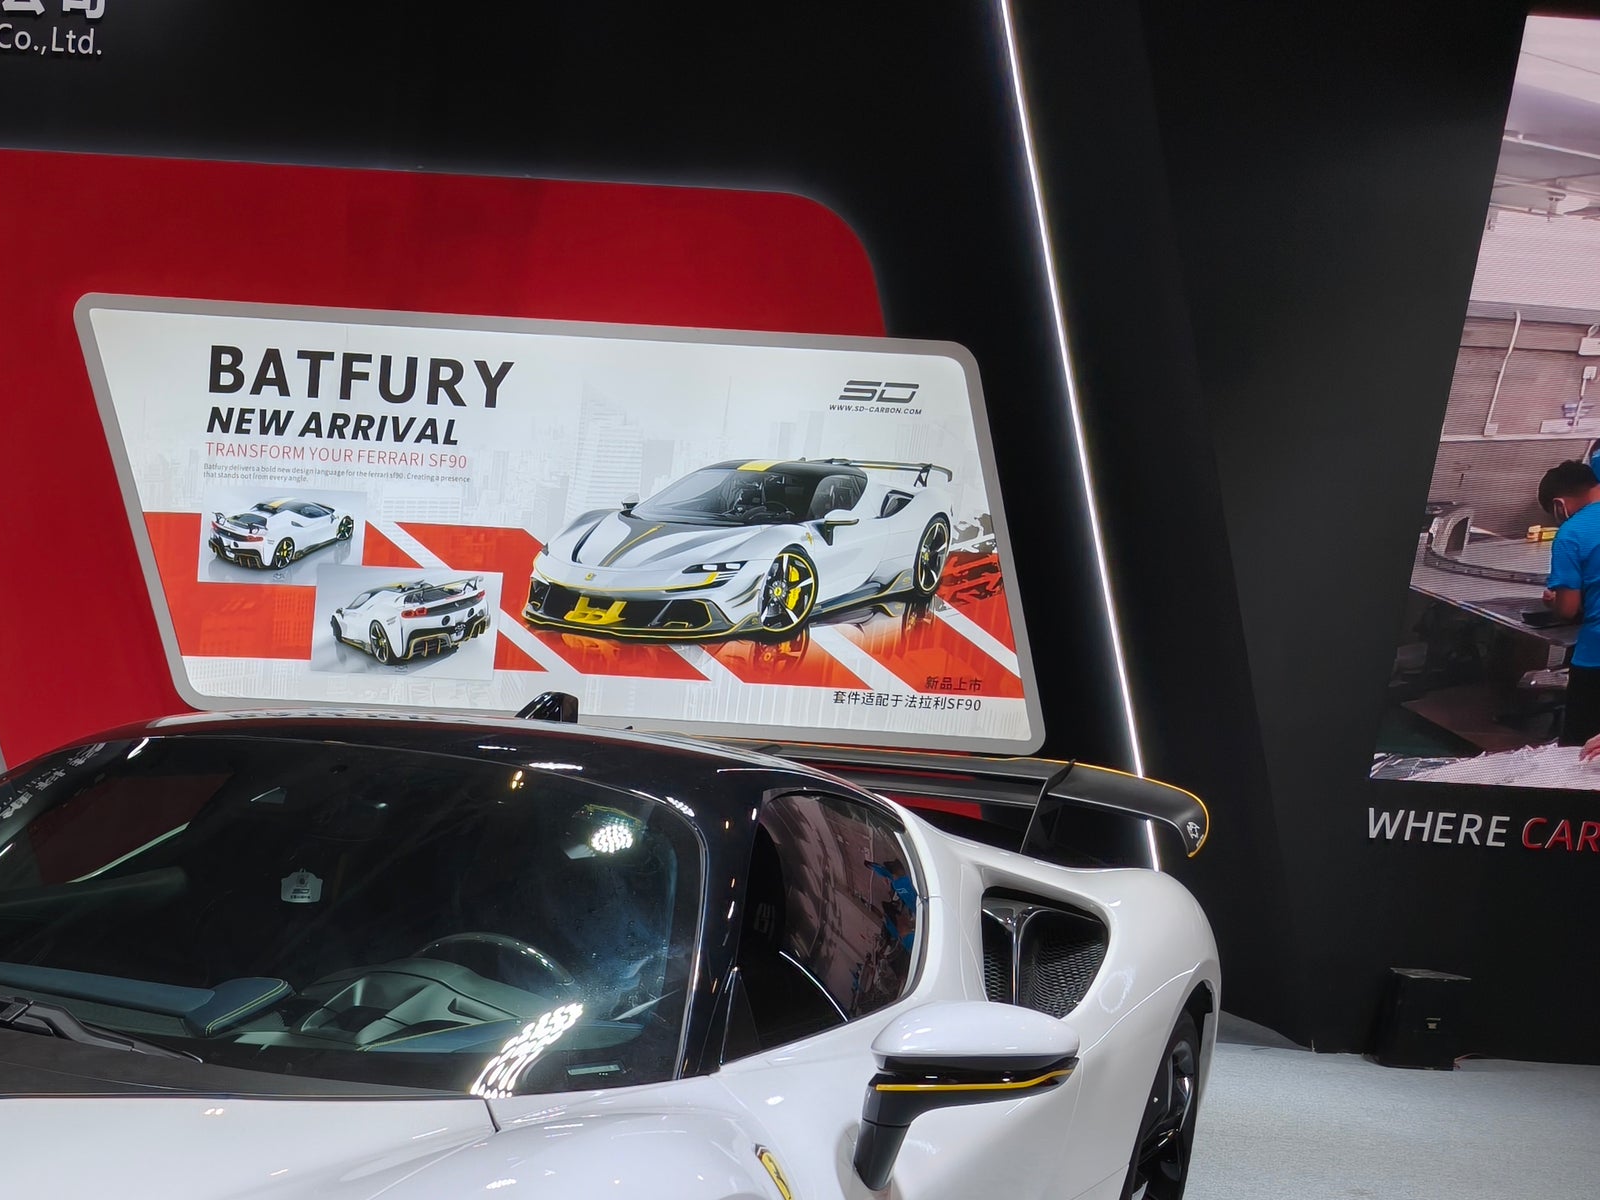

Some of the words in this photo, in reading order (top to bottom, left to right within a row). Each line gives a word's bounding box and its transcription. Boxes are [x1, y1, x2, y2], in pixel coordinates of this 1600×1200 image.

[208, 344, 515, 409] BATFURY
[838, 379, 920, 404] SD
[829, 403, 922, 415] WWW.SD-CARBON.COM
[206, 406, 295, 437] NEW
[297, 411, 459, 446] ARRIVAL
[205, 441, 305, 460] TRANSFORM
[309, 446, 354, 462] YOUR
[357, 449, 424, 467] FERRARI
[429, 453, 467, 469] SF90
[925, 675, 983, 693] 新品上市
[833, 690, 982, 712] 套件适配于法拉利SF90
[1368, 807, 1510, 848] WHERE
[1521, 817, 1600, 853] CAR
